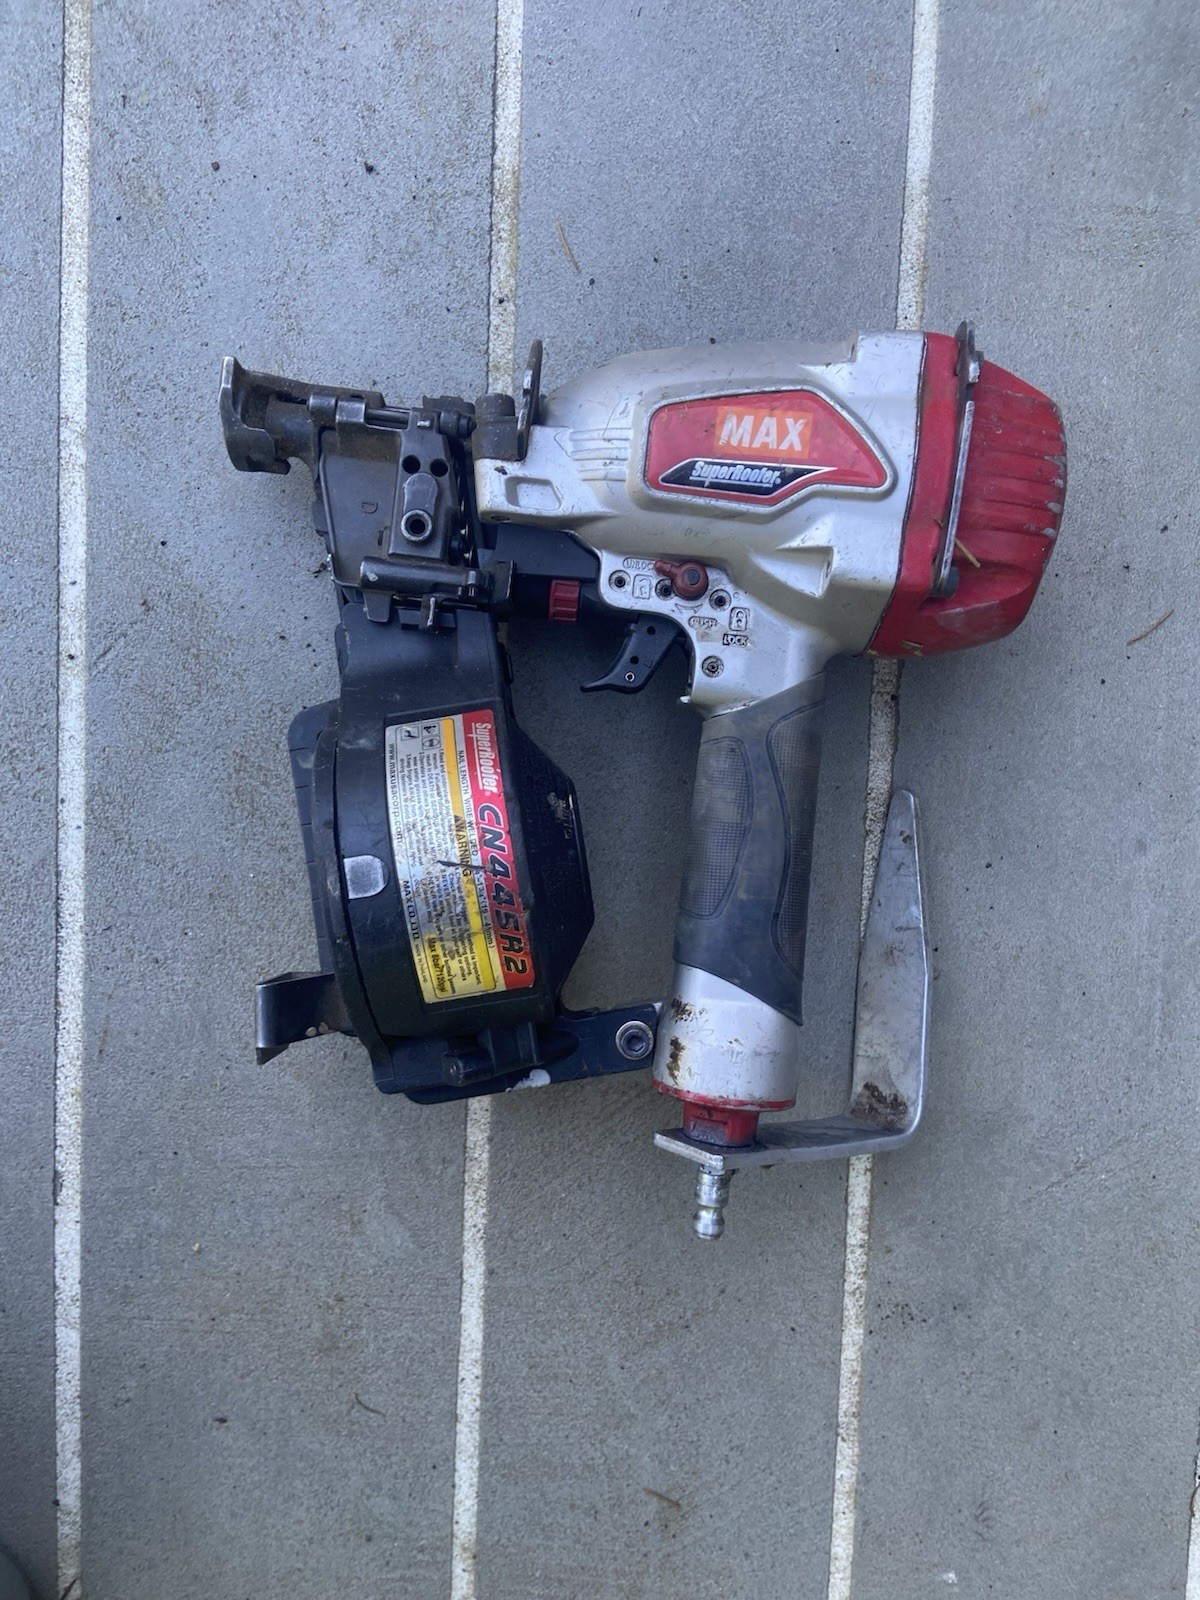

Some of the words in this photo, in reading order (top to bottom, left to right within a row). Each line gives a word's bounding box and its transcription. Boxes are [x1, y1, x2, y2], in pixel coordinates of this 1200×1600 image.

[718, 412, 808, 452] MAX
[690, 461, 781, 488] SuperRoofer
[723, 633, 749, 647] LOCK
[457, 749, 465, 764] NAIL
[467, 722, 498, 796] SuperRoofer
[388, 743, 403, 843] www.maxusacorp.com
[458, 765, 469, 794] LENGTH
[463, 797, 473, 818] WIRE
[454, 821, 471, 876] WARNING
[467, 820, 478, 856] WELDED
